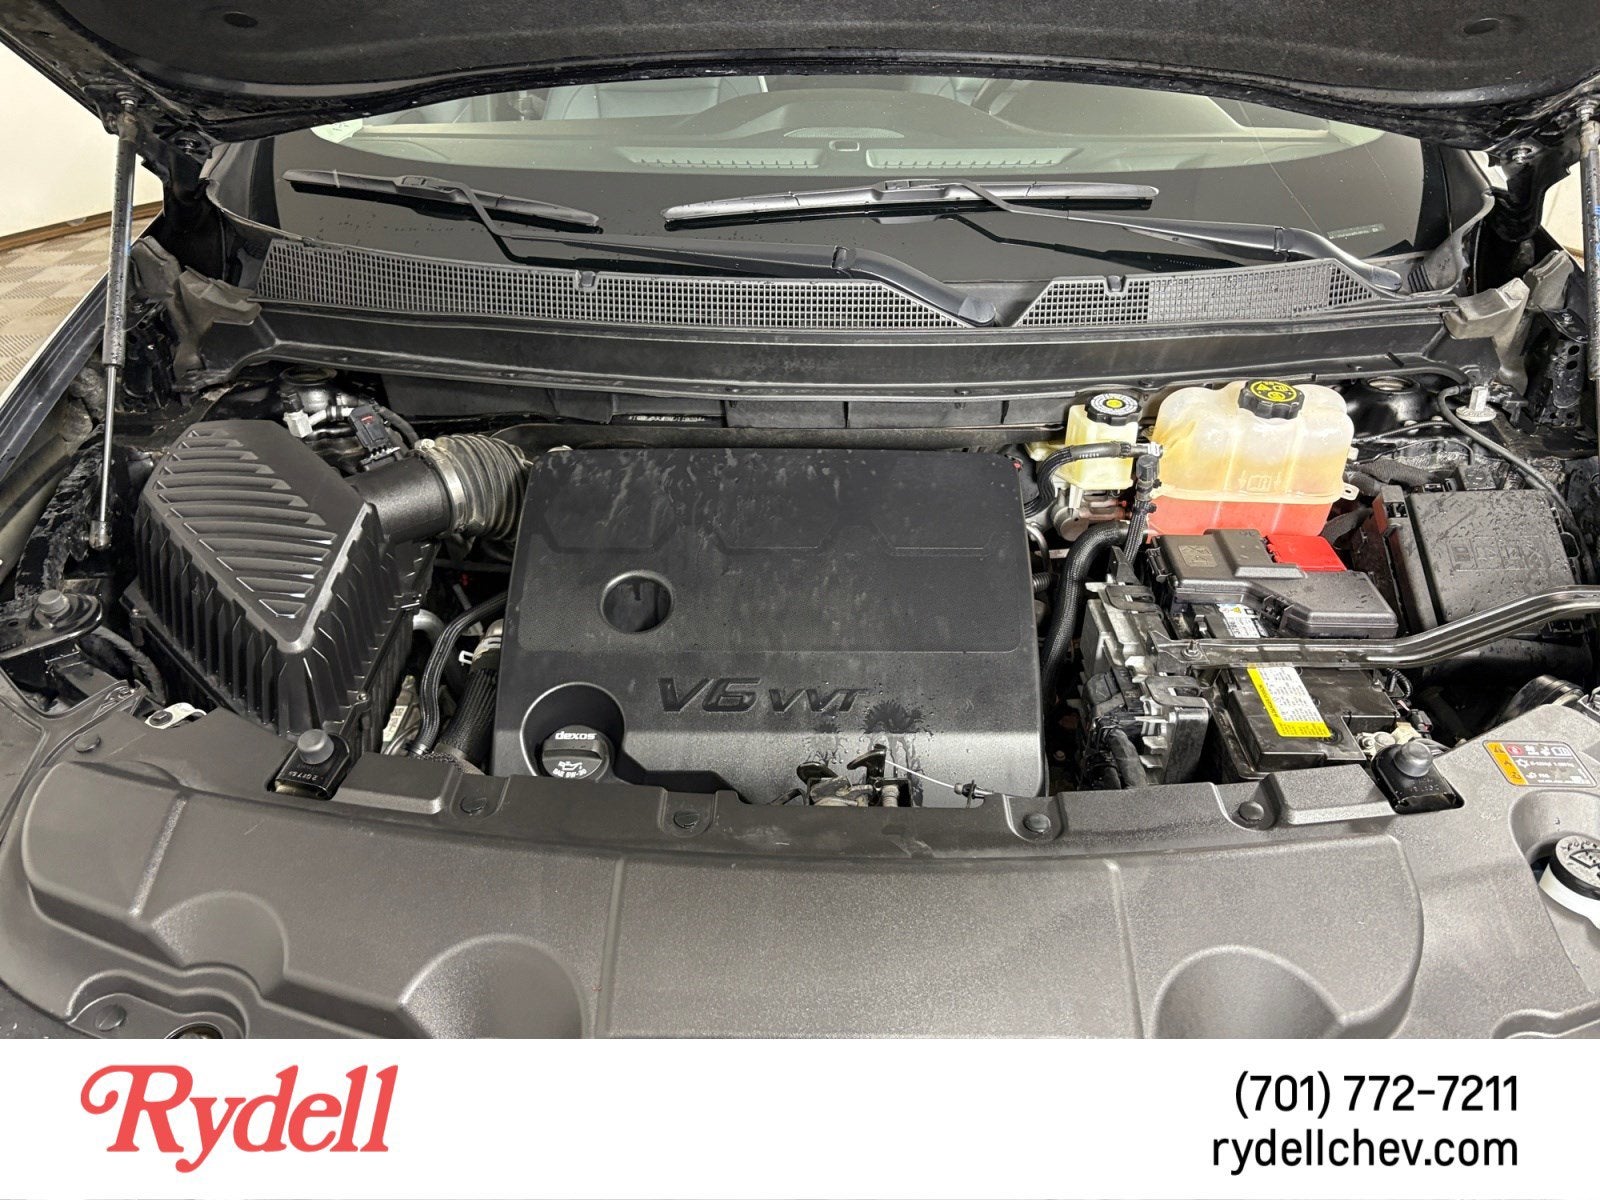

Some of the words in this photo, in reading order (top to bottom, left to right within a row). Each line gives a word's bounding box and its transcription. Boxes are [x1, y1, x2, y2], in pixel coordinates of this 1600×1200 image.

[657, 677, 761, 713] V6
[768, 688, 868, 713] VVT
[554, 730, 597, 740] dexos
